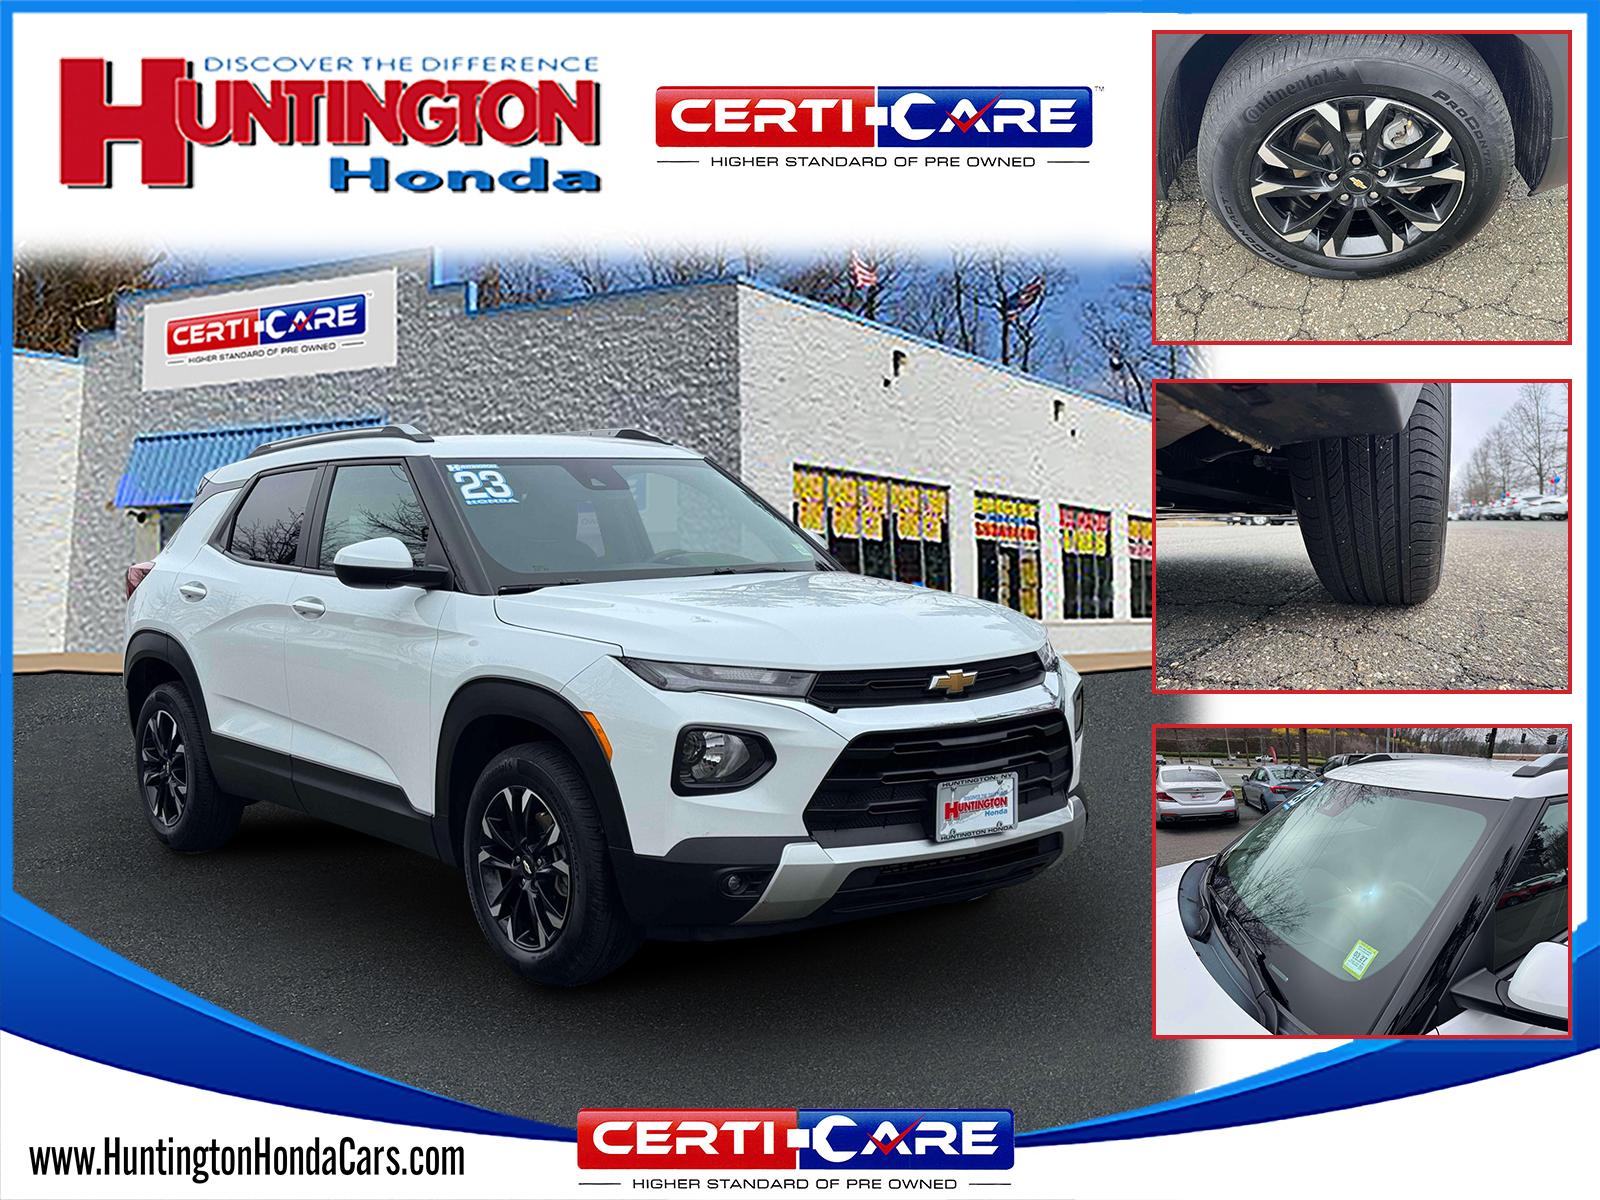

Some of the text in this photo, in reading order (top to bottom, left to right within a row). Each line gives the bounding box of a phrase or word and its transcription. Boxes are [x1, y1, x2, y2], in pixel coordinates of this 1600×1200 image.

[1241, 68, 1331, 124] Continental
[188, 342, 336, 364] HIGHER STANDARD OF PRE OWNED
[453, 470, 514, 500] 23
[944, 796, 1008, 820] HUNTINGTON
[984, 808, 1008, 817] Honda
[941, 825, 1014, 841] HUNTINGTON HONDA
